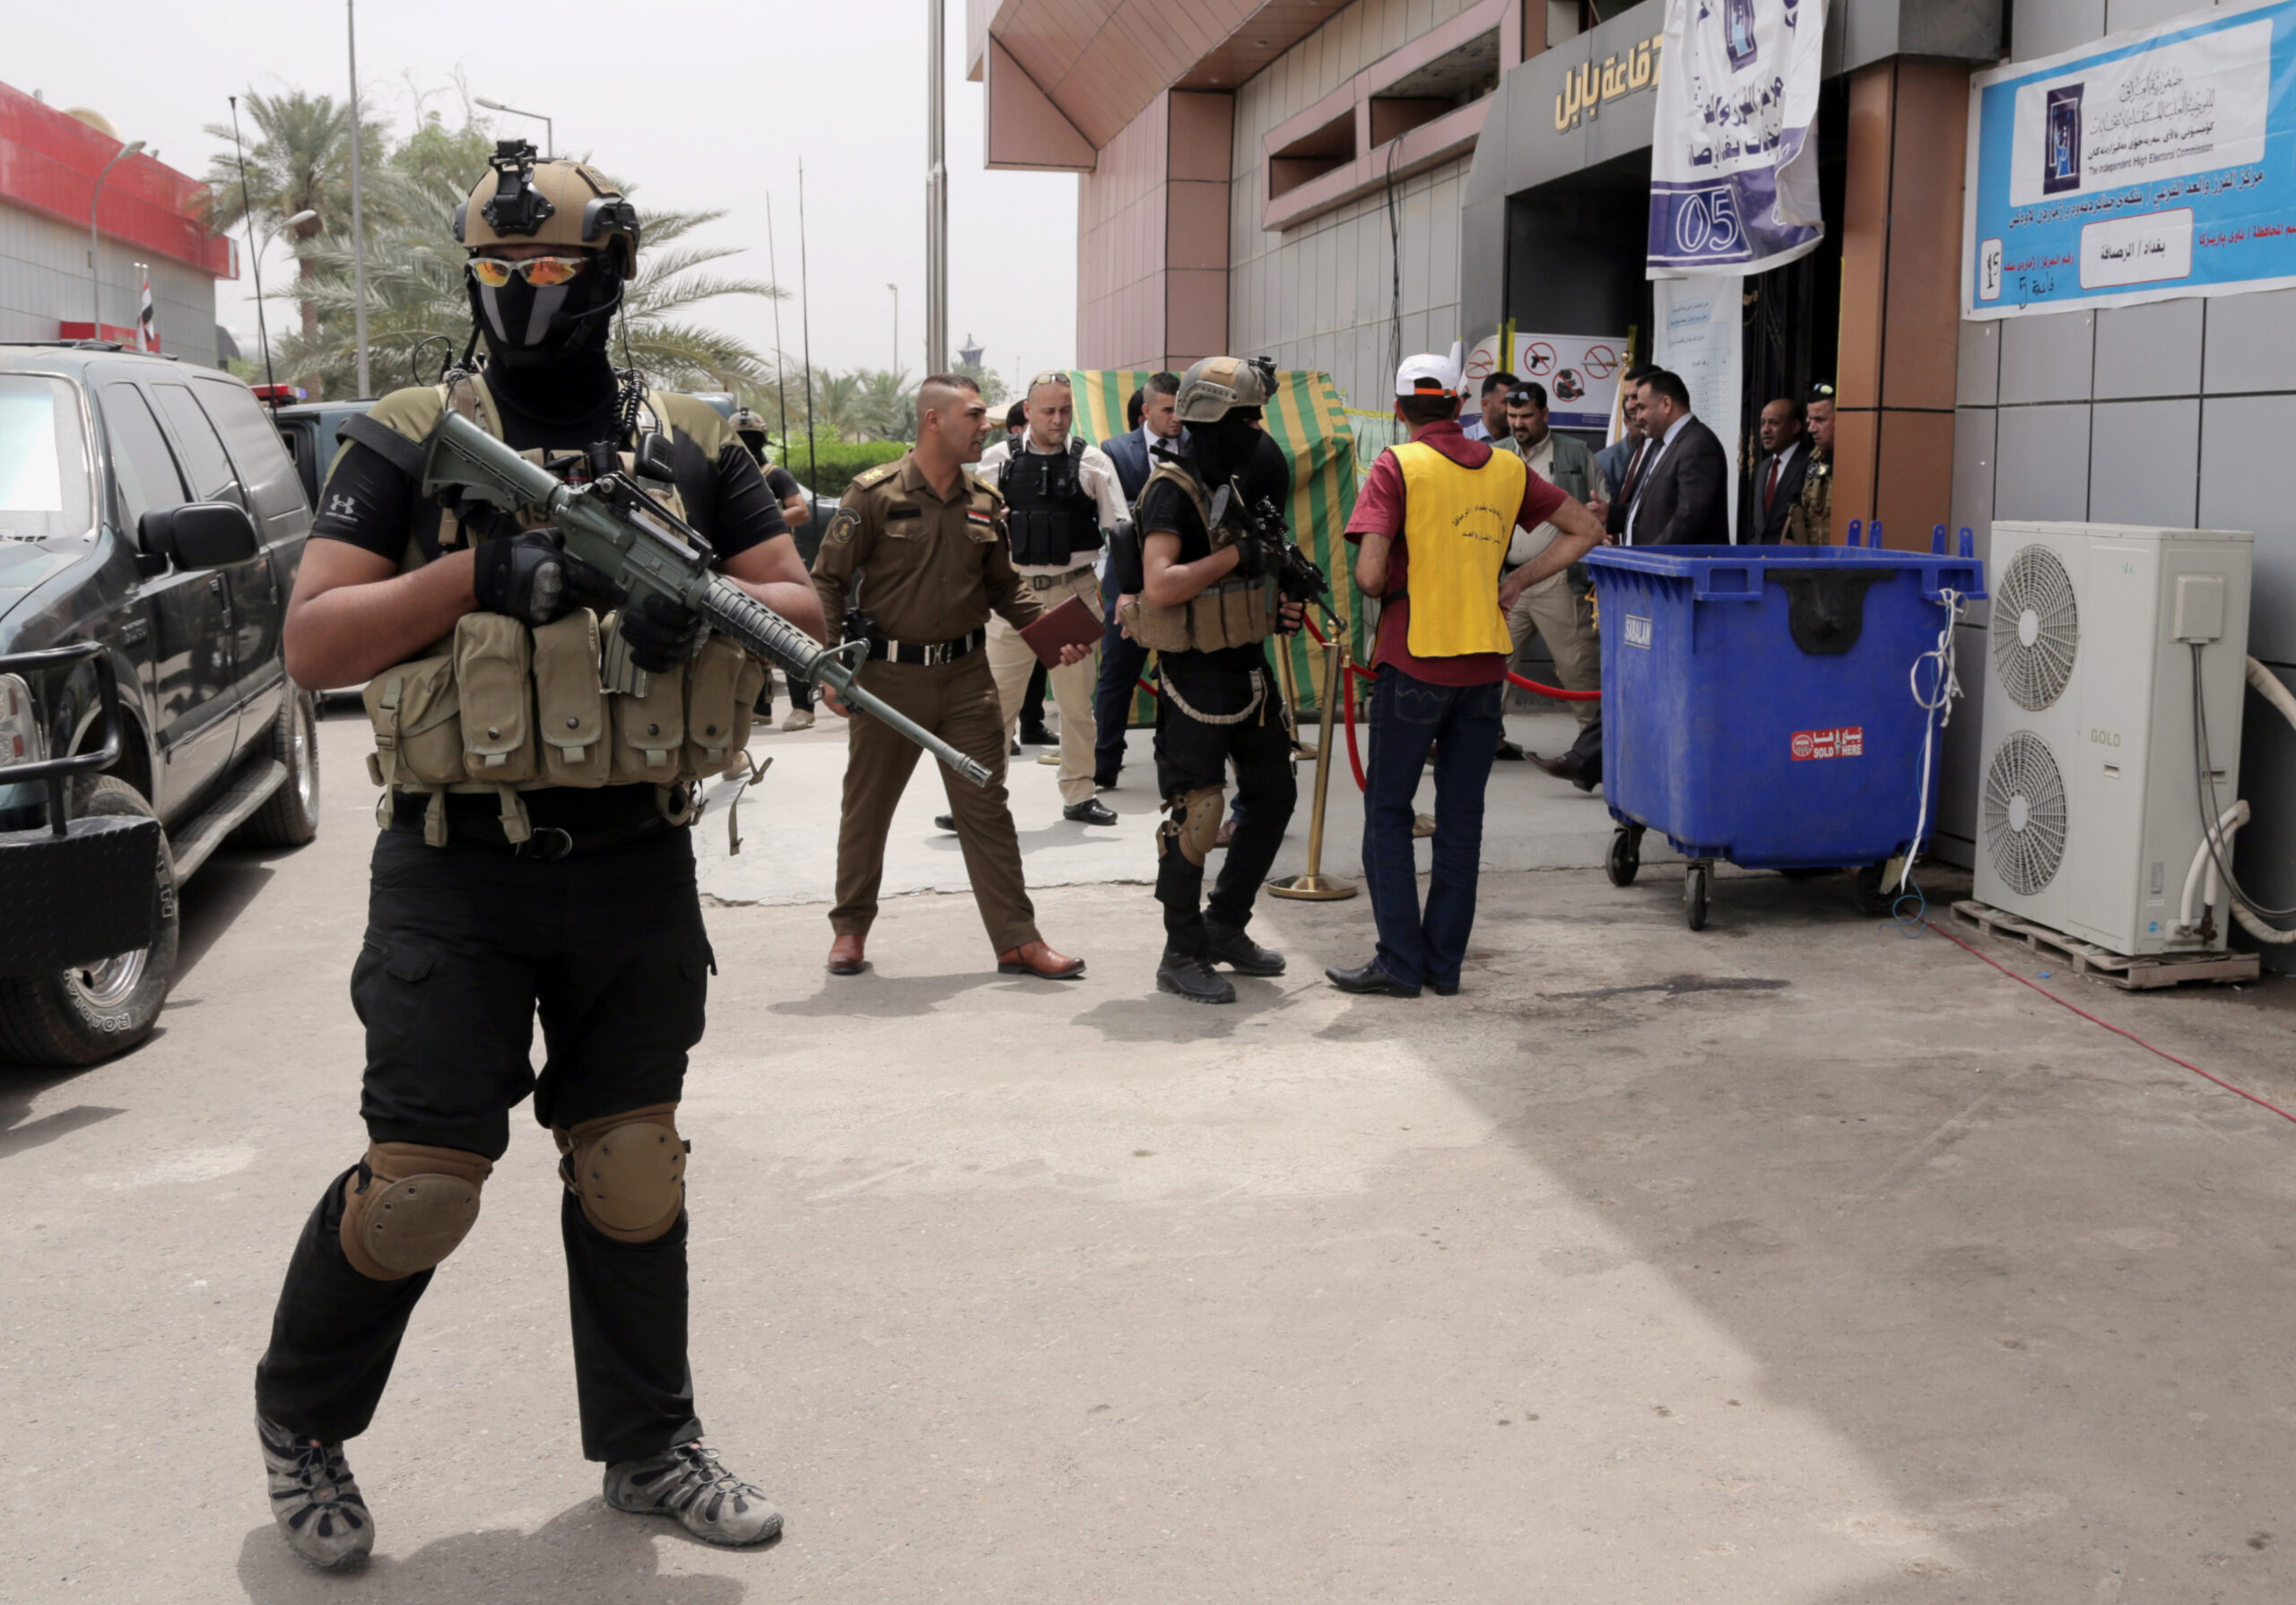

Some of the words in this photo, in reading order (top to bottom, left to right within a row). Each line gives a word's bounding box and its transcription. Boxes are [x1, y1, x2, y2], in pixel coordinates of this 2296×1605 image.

[1602, 39, 1650, 100] قاعة
[1554, 61, 1600, 130] بابل
[2099, 158, 2132, 174] Independent
[2133, 155, 2147, 169] High
[2148, 150, 2175, 163] Electoral
[2176, 143, 2214, 158] Commission
[2238, 168, 2264, 189] مركز
[1676, 190, 1738, 252] 05
[2100, 240, 2135, 262] الرصافة
[2144, 239, 2166, 257] بغداد
[2091, 728, 2121, 748] GOLD
[1813, 746, 1834, 759] SOLD
[1842, 743, 1862, 757] HERE
